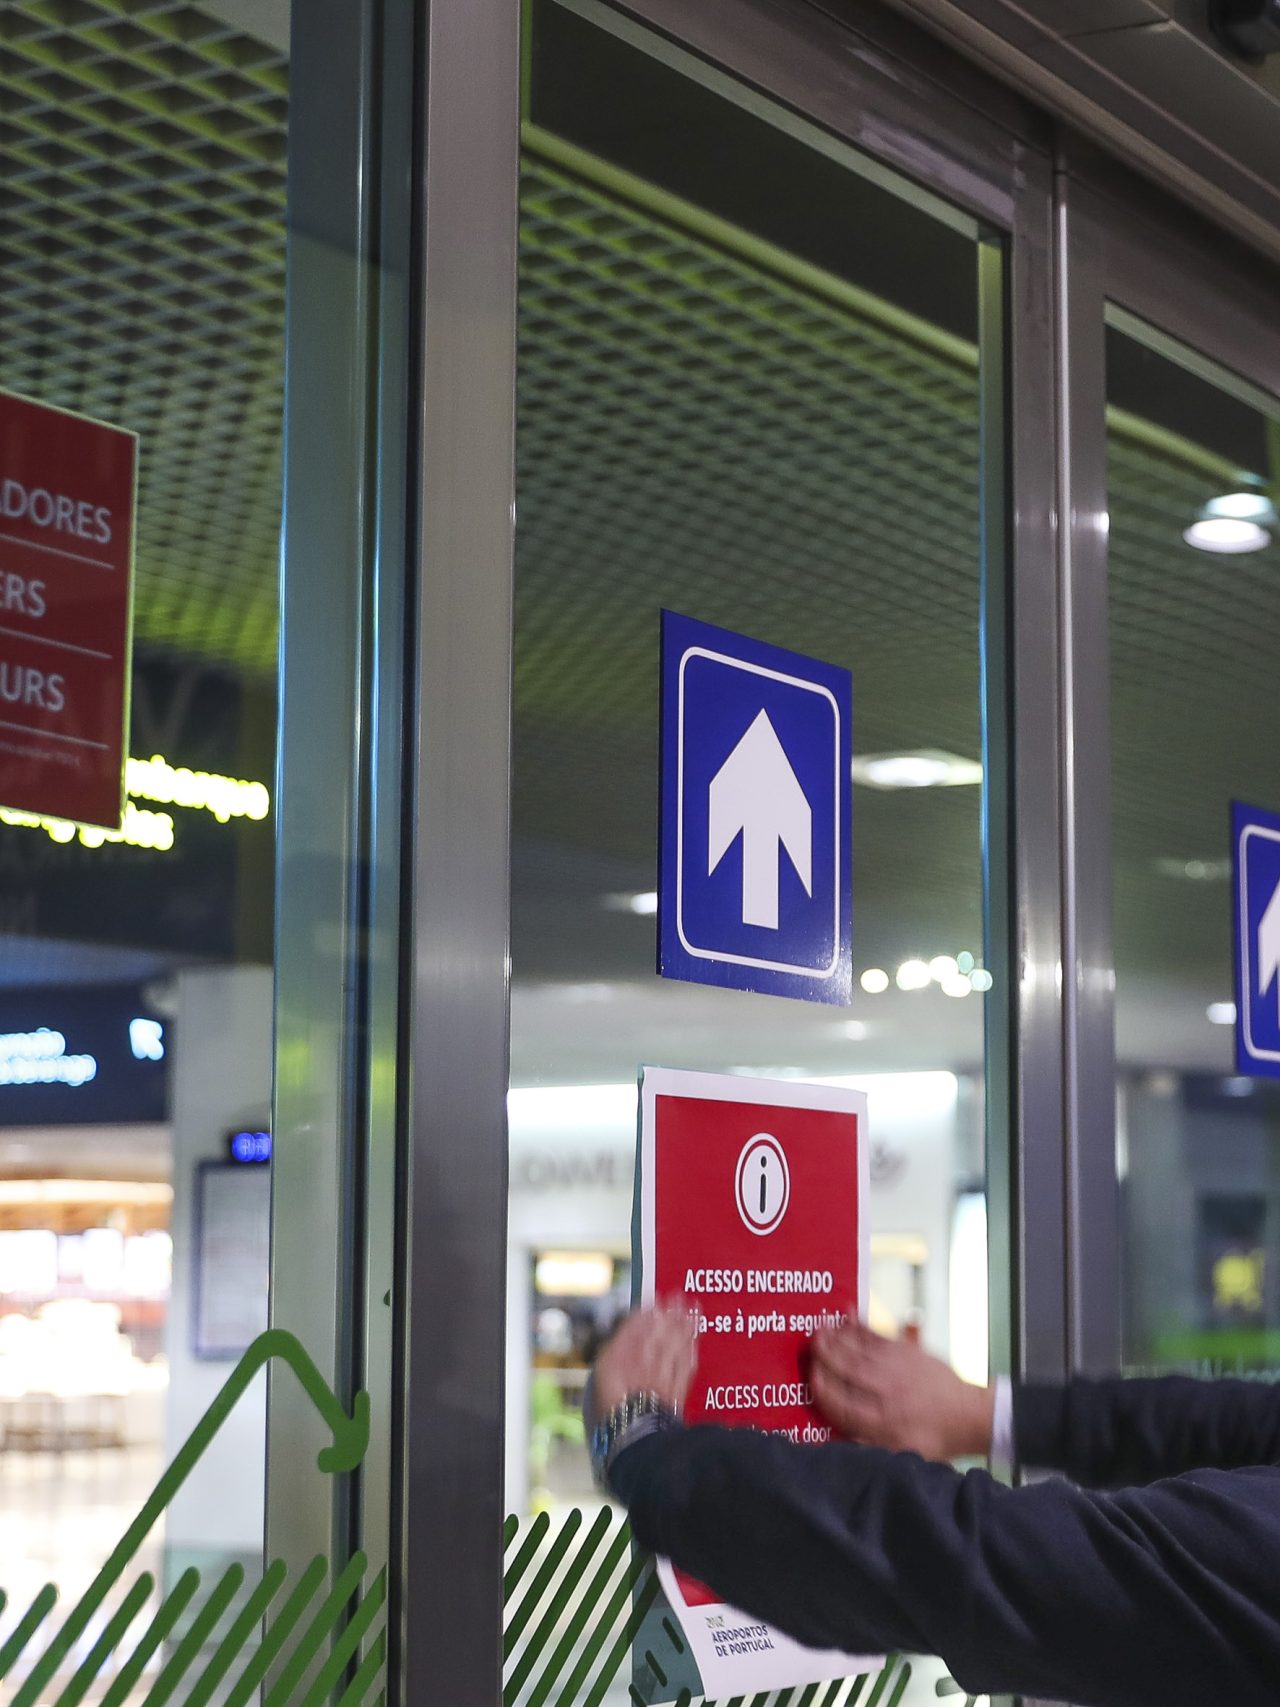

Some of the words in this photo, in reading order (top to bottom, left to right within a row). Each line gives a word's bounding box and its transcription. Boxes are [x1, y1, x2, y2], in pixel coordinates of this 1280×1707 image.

[0, 479, 113, 544] DORES
[684, 1269, 743, 1293] ACESSO
[747, 1270, 833, 1293] ENCERRADO
[686, 1308, 732, 1340] ija-se
[735, 1308, 744, 1333] à
[748, 1310, 786, 1339] porta
[705, 1385, 760, 1410] ACCESS
[763, 1383, 814, 1407] CLOSED
[802, 1421, 832, 1443] door
[712, 1625, 768, 1643] AEROPORTOS
[715, 1645, 729, 1657] DE
[728, 1638, 775, 1656] PORTUGAL
